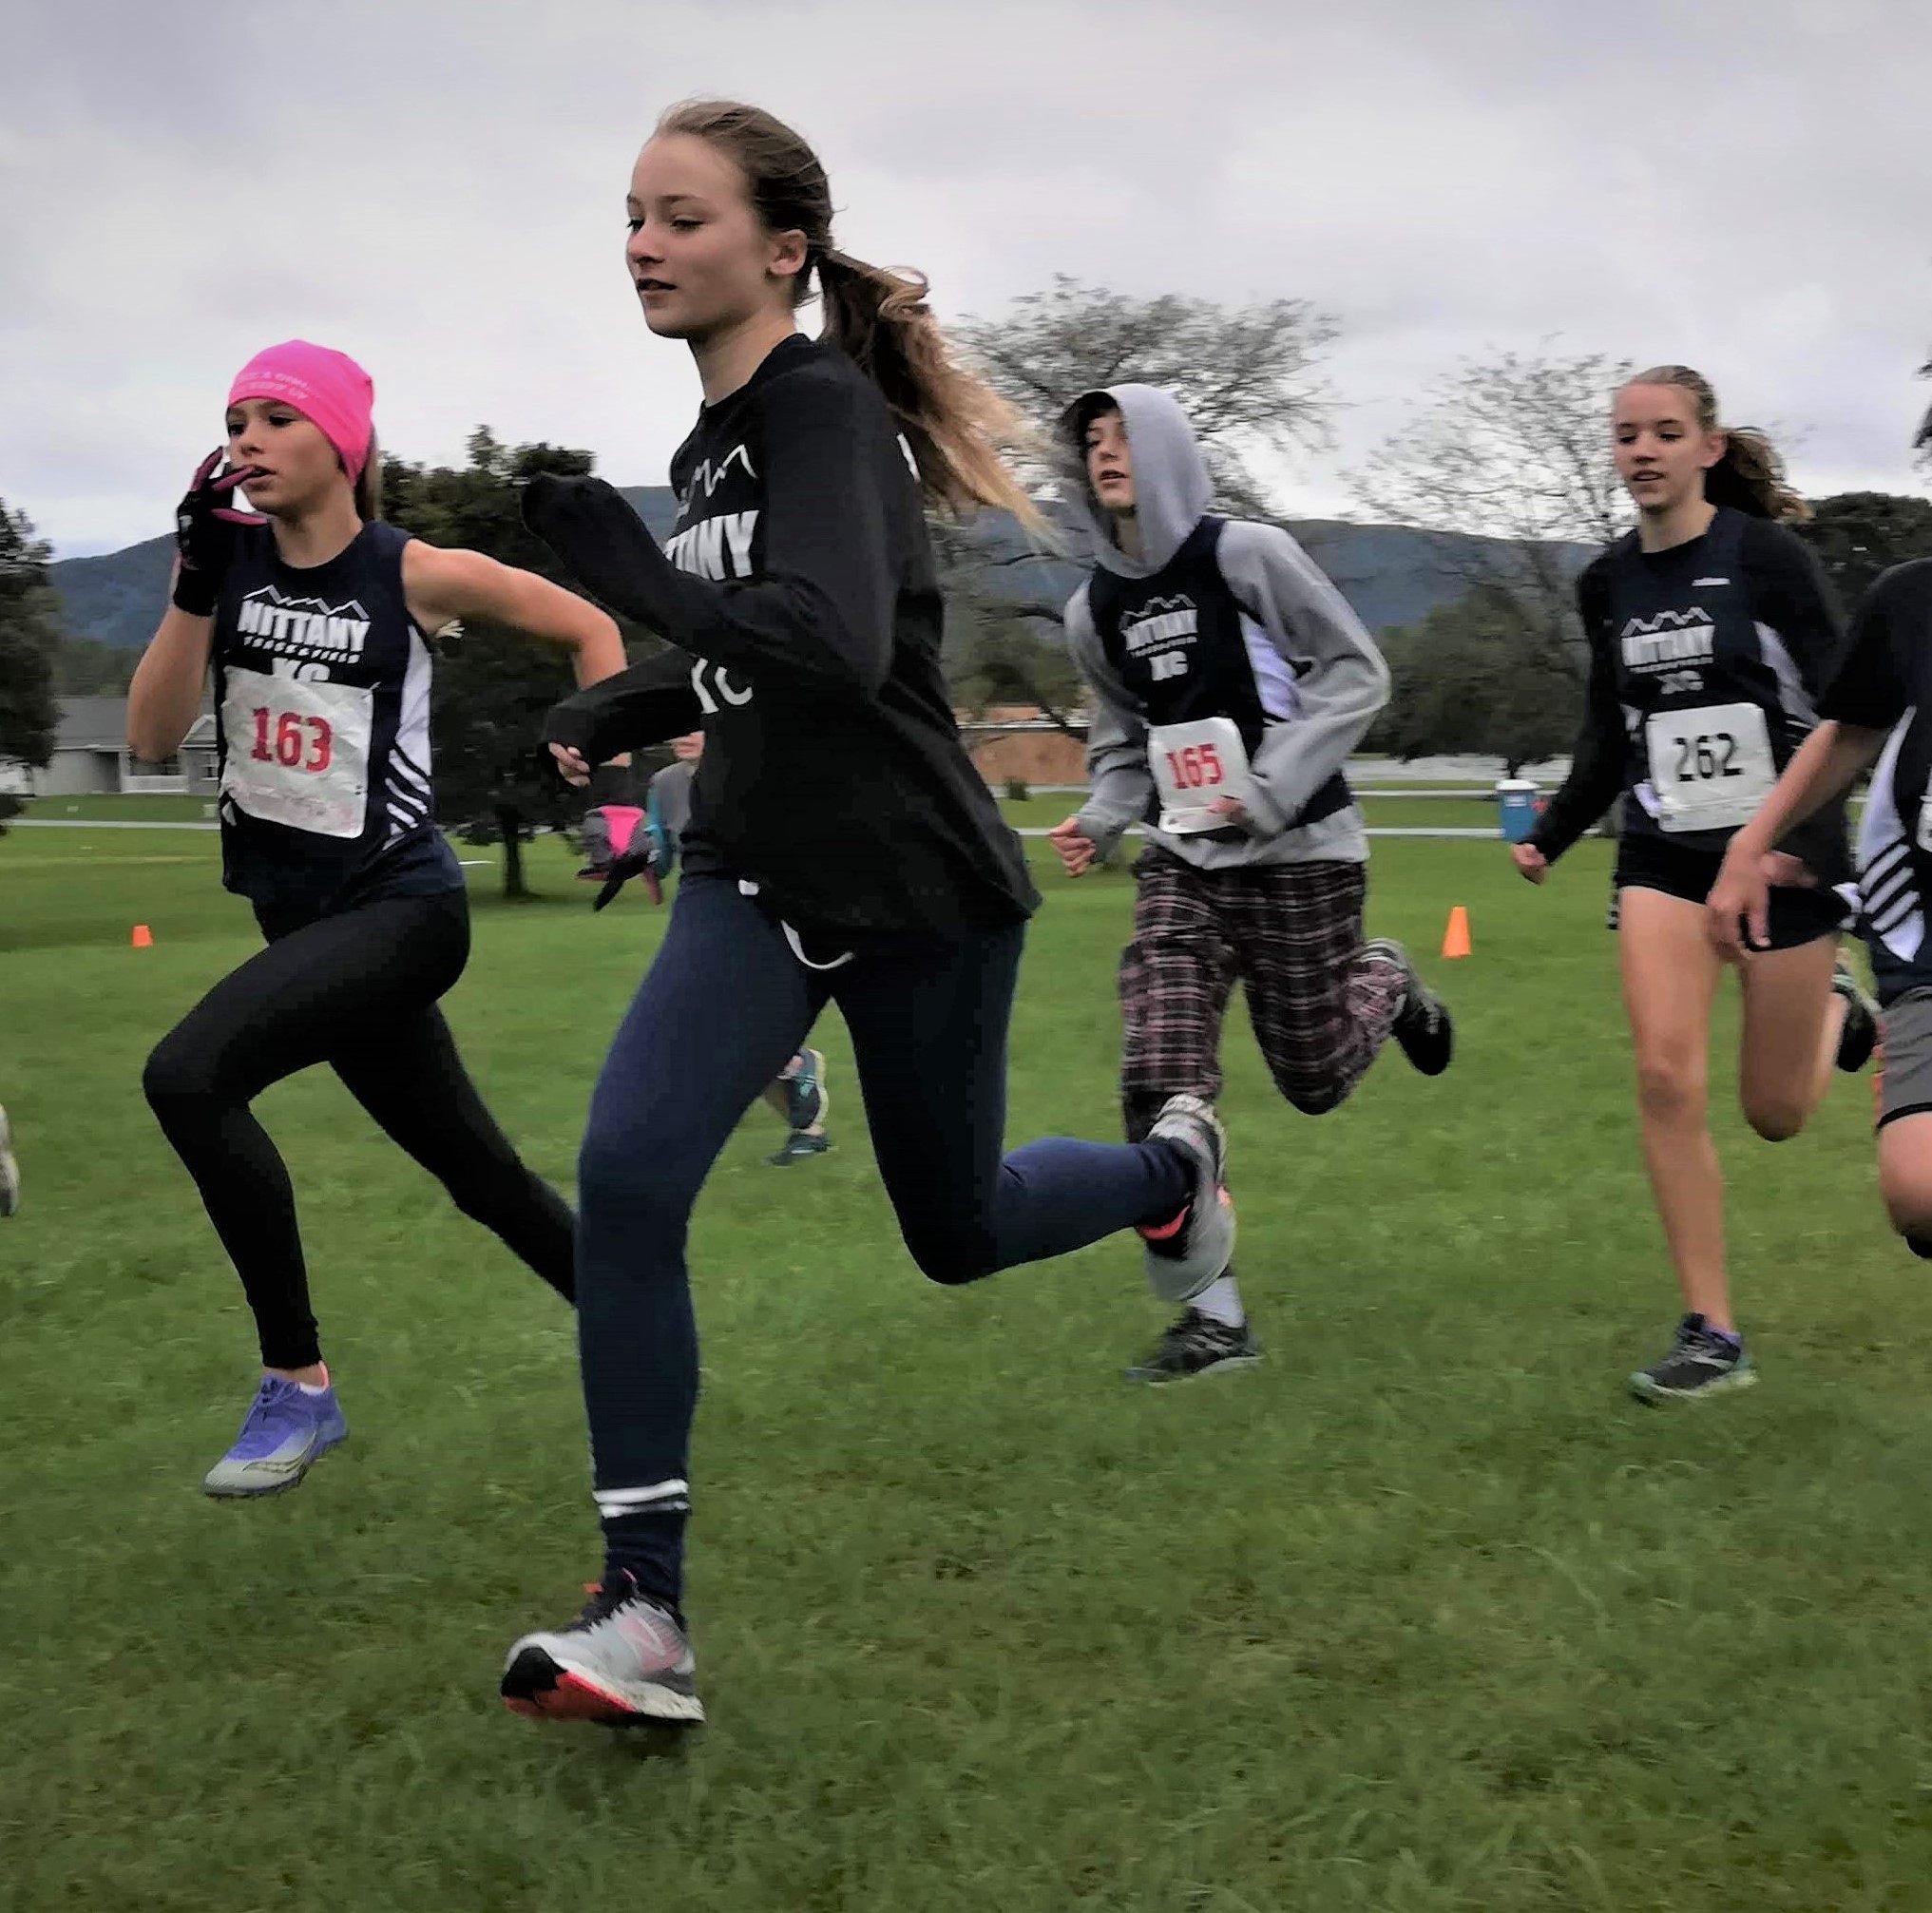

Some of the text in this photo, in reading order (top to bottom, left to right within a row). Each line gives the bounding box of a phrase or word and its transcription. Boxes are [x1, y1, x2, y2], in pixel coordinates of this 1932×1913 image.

[238, 600, 371, 652] NITTANY
[251, 707, 333, 773] 163
[1674, 732, 1744, 782] 262
[1165, 742, 1224, 790] 165
